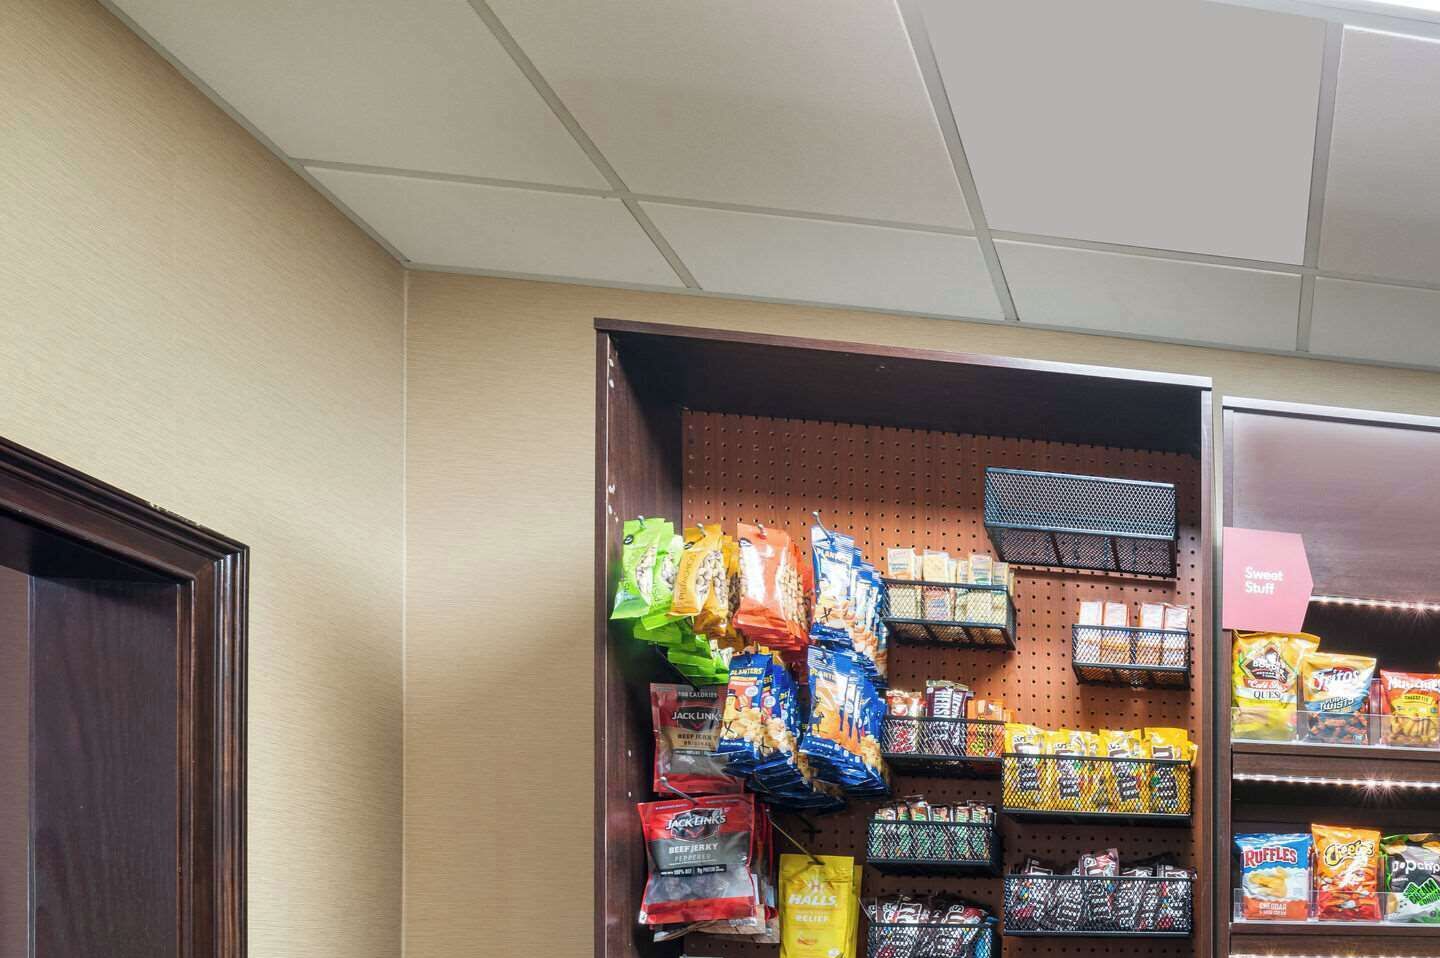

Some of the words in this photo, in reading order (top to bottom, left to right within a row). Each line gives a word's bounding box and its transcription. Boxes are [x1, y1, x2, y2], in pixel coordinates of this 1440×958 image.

[1244, 567, 1284, 581] Sweet
[1244, 581, 1275, 595] Stuff
[729, 667, 763, 676] PLANTERS
[671, 711, 695, 721] JACK
[666, 819, 693, 830] JACK
[668, 845, 690, 854] BEEF
[691, 843, 719, 853] JERKY
[1244, 846, 1297, 868] RUFFLES
[787, 895, 837, 906] HALLS
[795, 914, 829, 923] RELIEF
